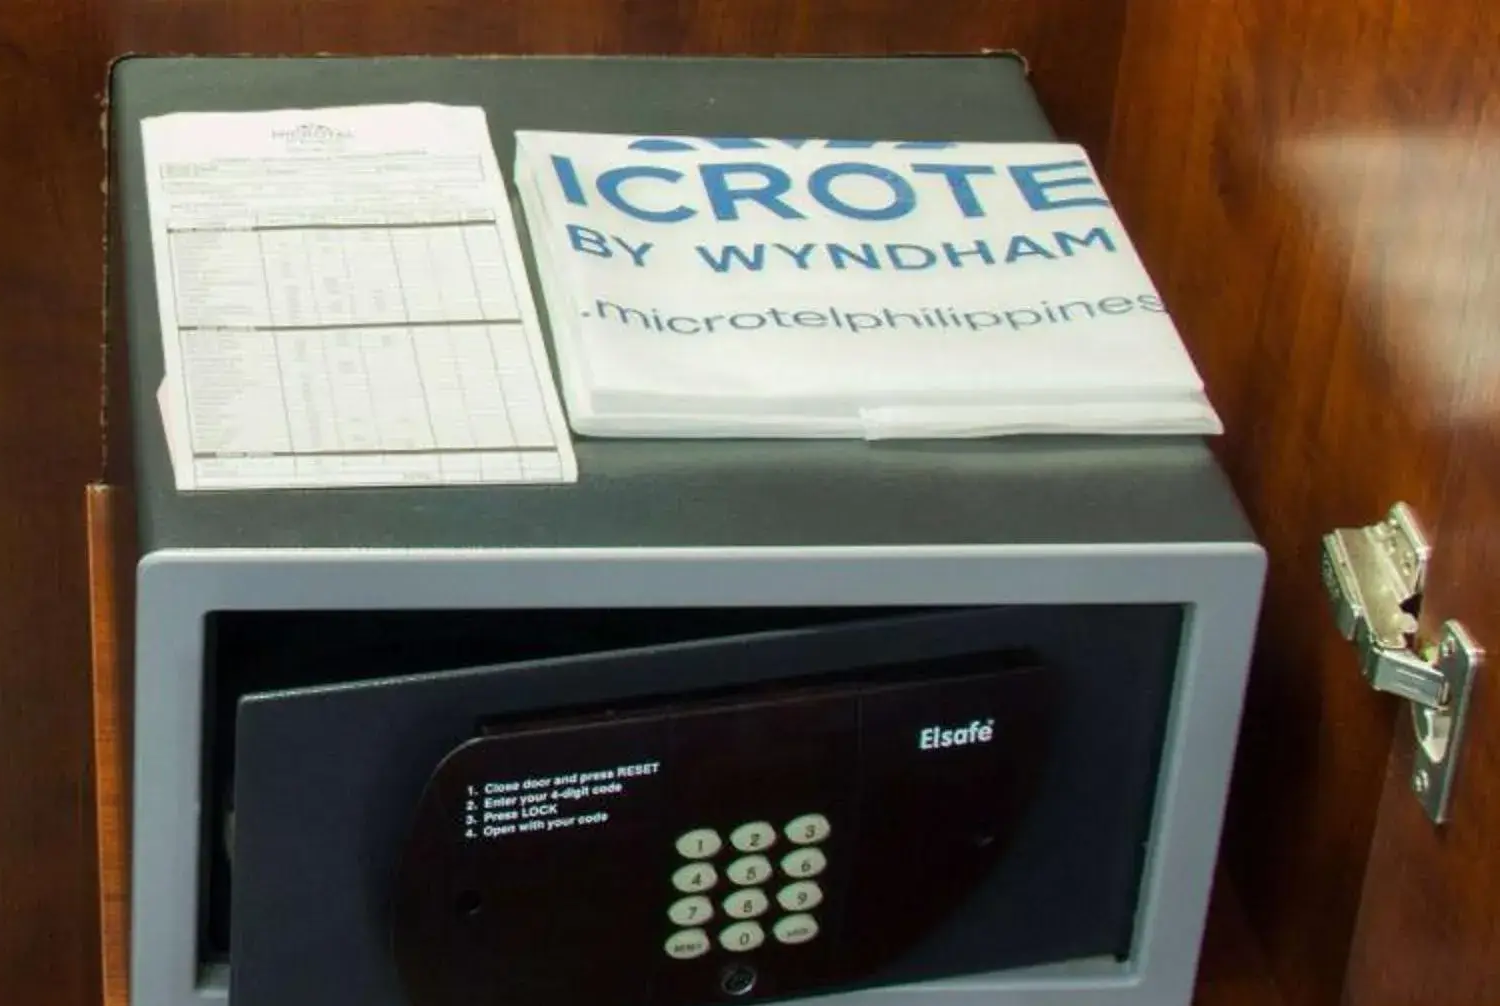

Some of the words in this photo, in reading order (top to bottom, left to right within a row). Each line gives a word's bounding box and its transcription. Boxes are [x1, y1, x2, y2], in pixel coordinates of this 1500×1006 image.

[550, 154, 1110, 224] ICROTE
[565, 223, 655, 268] BY
[695, 226, 1117, 274] WYNDHAM
[467, 785, 479, 797] 1.
[484, 782, 520, 794] Close
[522, 775, 550, 789] door
[554, 772, 577, 786] and
[579, 770, 614, 784] press
[616, 762, 660, 777] RESET
[466, 800, 478, 811] 2.
[484, 796, 517, 809] Enter
[520, 792, 548, 806] your
[551, 785, 589, 801] 4-digit
[592, 782, 622, 795] code
[465, 814, 478, 825] 3.
[483, 810, 518, 822] Press
[521, 803, 558, 818] LOCK
[465, 829, 478, 839] 4.
[483, 823, 516, 837] Open
[519, 818, 545, 832] with
[547, 816, 575, 831] your
[578, 811, 609, 824] code
